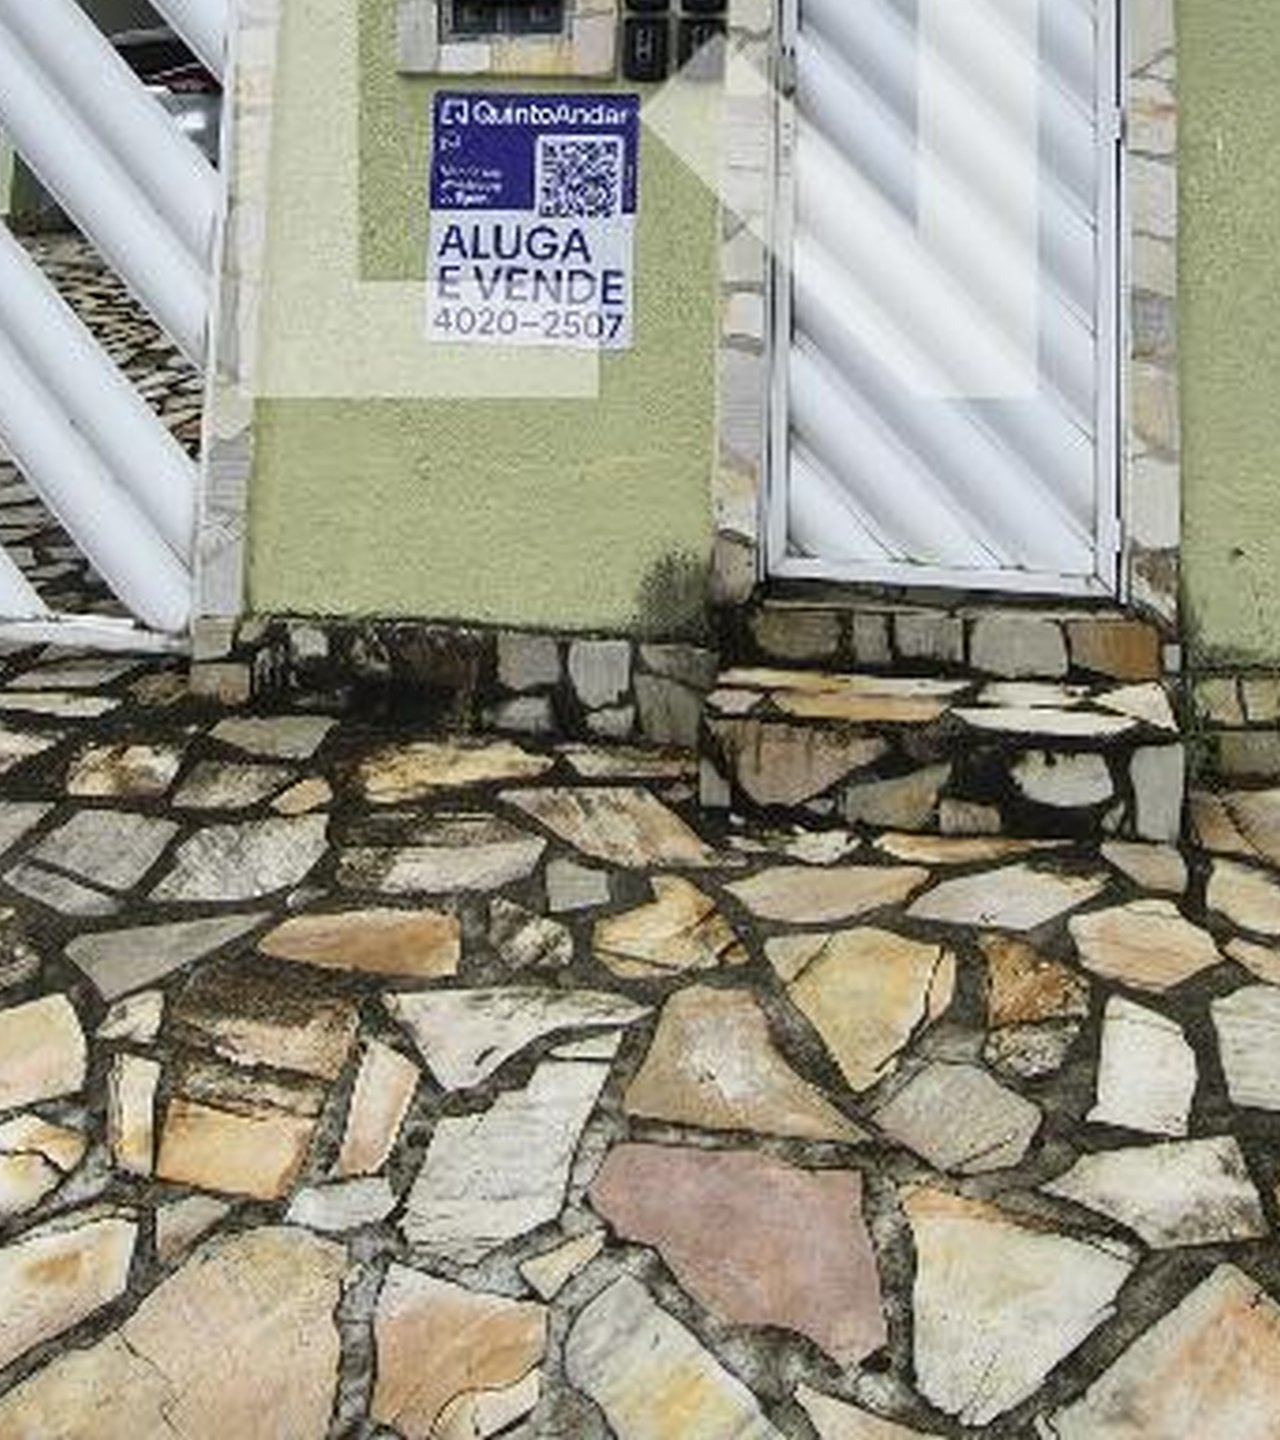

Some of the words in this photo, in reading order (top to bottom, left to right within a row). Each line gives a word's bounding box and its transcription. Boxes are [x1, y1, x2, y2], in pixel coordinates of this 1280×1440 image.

[472, 100, 628, 125] QuintoAndar
[437, 224, 592, 263] ALUGA
[437, 265, 462, 300] E
[473, 265, 625, 305] VENDE
[433, 307, 623, 339] 4020-2507
